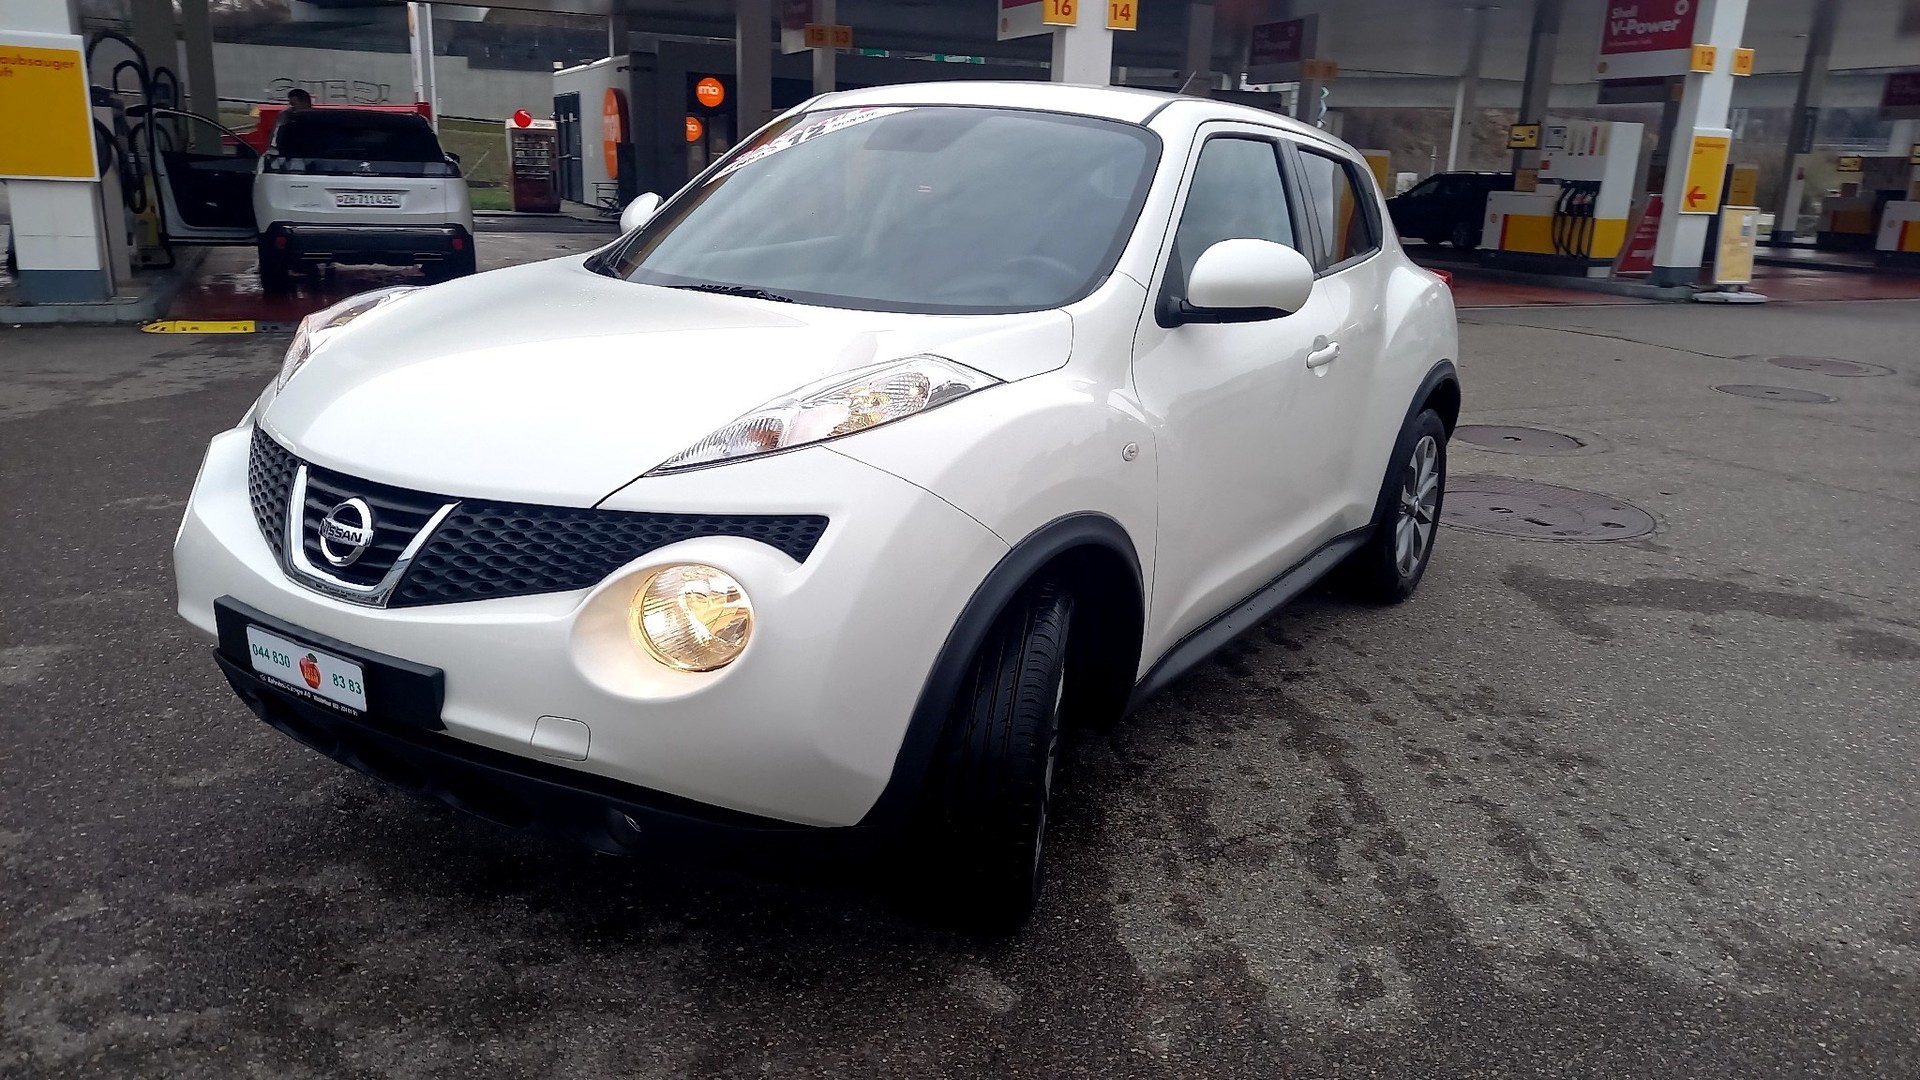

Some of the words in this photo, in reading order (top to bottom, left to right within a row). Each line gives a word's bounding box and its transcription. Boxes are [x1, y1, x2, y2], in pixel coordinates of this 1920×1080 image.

[1053, 0, 1072, 16] 16
[1111, 3, 1131, 21] 14
[1611, 5, 1639, 19] Shell
[809, 28, 825, 41] 15
[1611, 19, 1681, 36] V-Power
[834, 30, 849, 43] 13
[1701, 50, 1714, 66] 12
[321, 520, 363, 543] NISSAN
[252, 643, 270, 660] 044
[272, 650, 291, 668] 830
[332, 673, 346, 689] 83
[348, 679, 362, 695] 83
